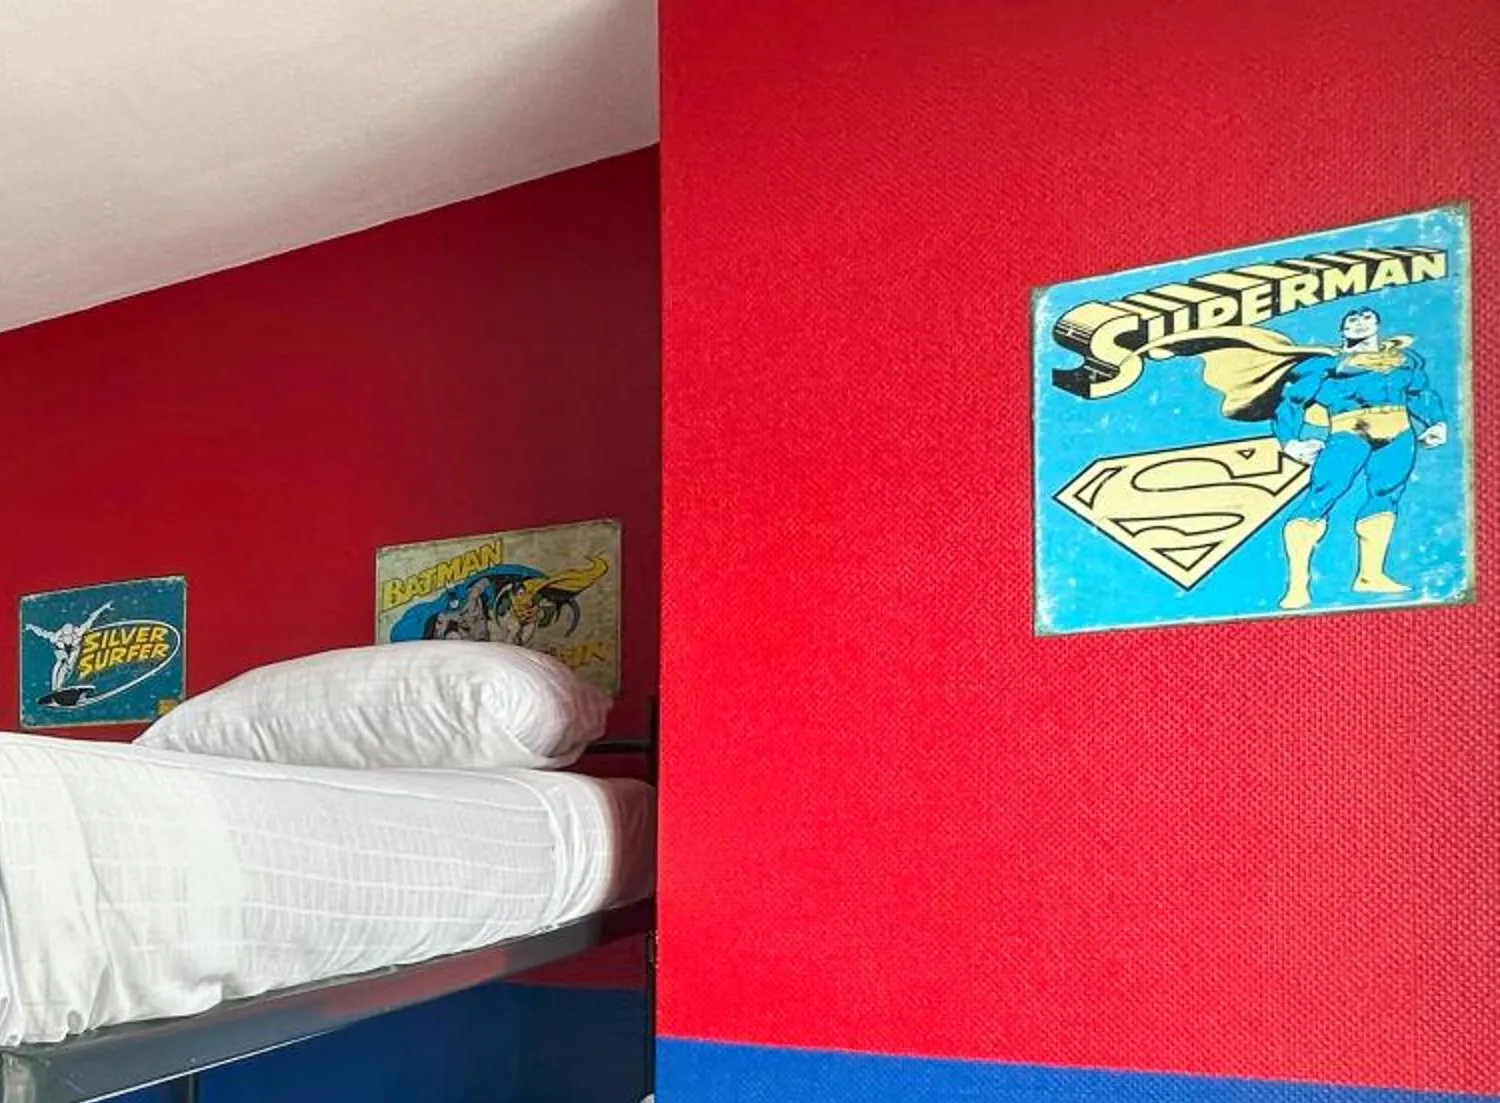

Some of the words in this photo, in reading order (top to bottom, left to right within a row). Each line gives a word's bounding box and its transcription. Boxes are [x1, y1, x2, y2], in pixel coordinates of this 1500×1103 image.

[1052, 247, 1448, 400] SUPERMAN
[382, 541, 504, 608] BATMAN
[77, 643, 170, 681] SURFER
[82, 626, 169, 652] SILVER
